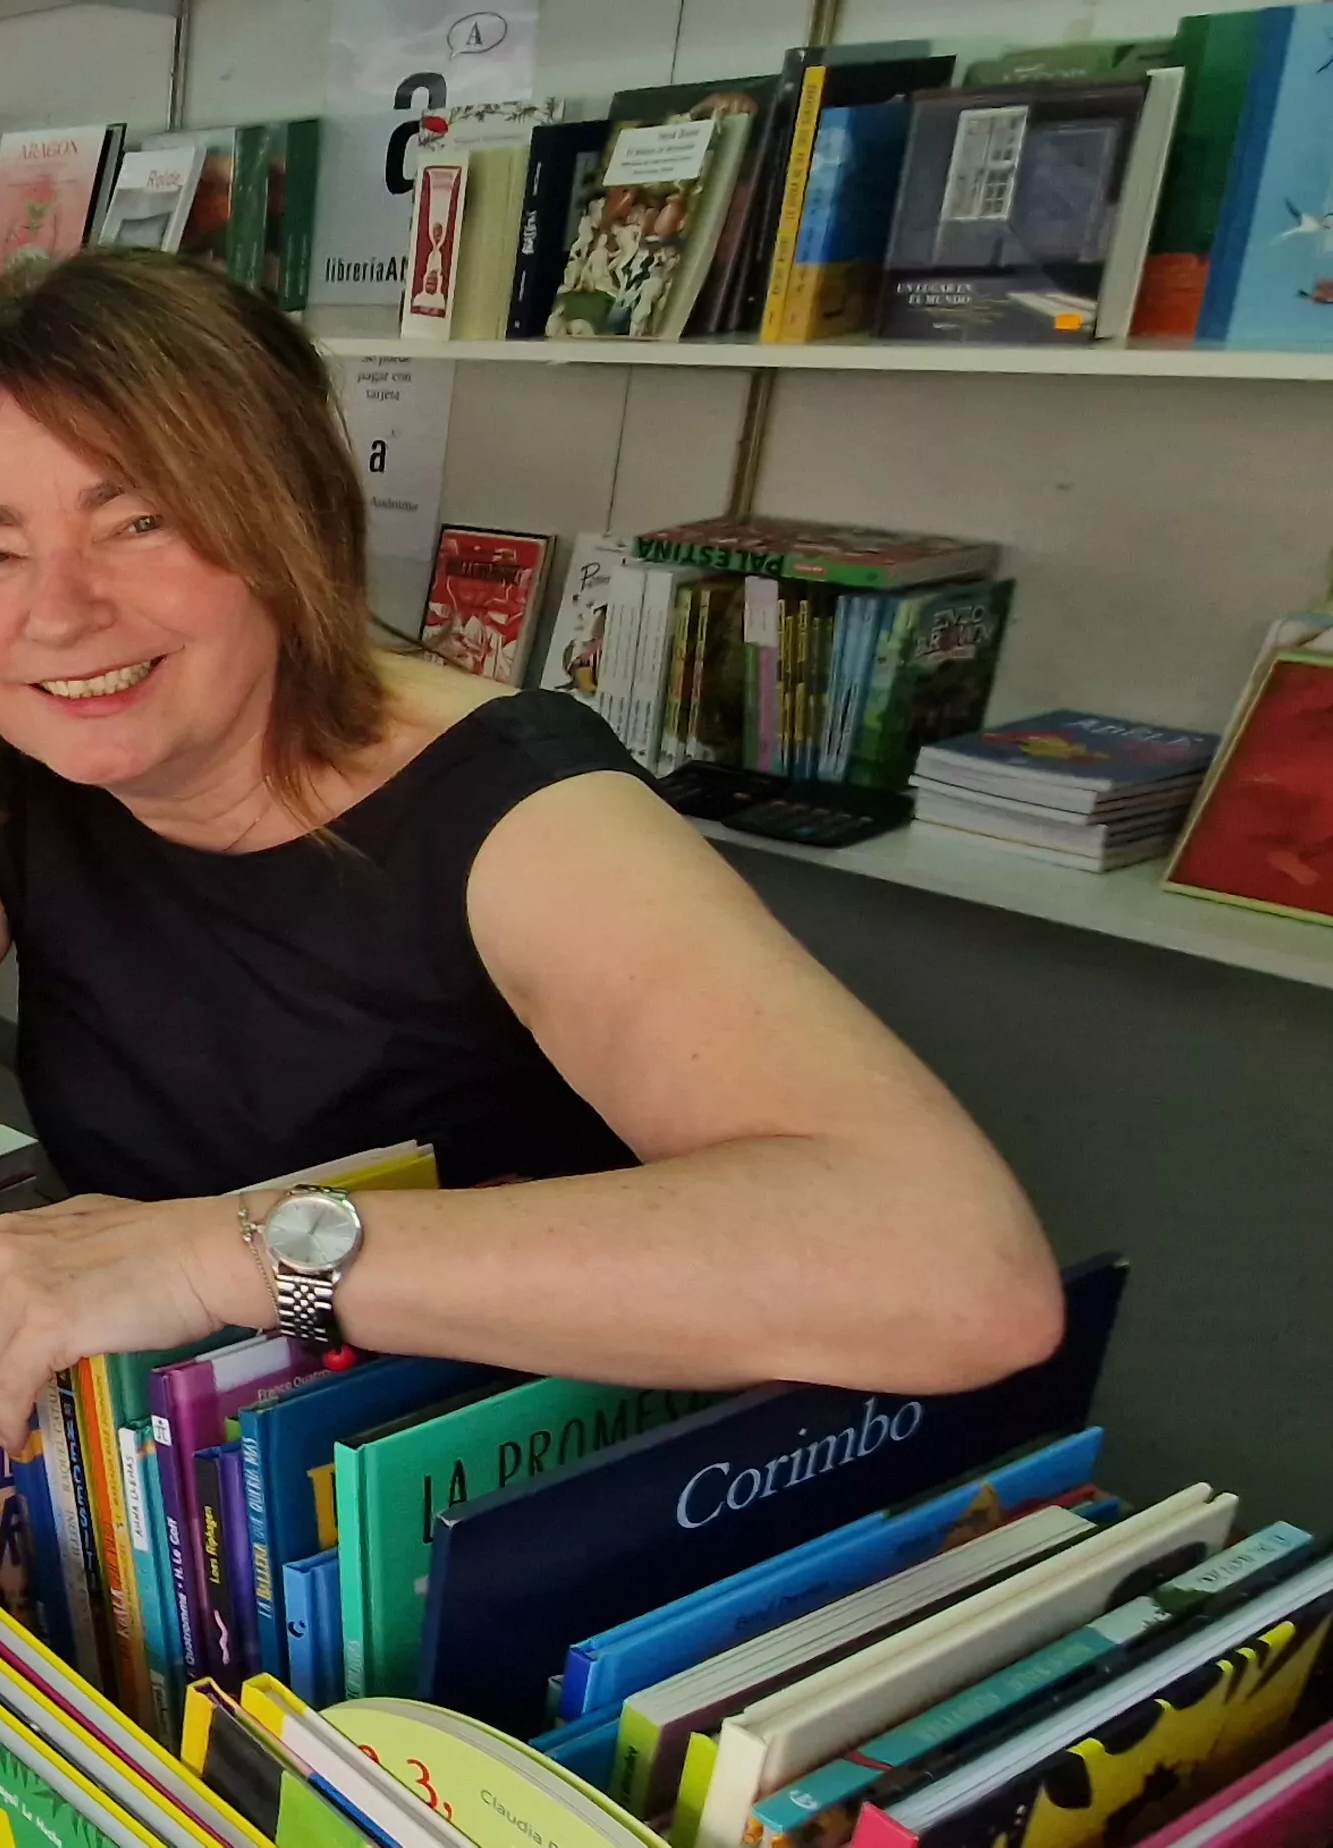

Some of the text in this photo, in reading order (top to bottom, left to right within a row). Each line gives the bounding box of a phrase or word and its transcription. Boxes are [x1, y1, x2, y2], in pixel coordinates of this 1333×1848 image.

[466, 21, 483, 46] A
[368, 438, 388, 474] a
[636, 537, 785, 575] PALESTINA
[56, 1443, 71, 1493] RAQUEL
[676, 1397, 923, 1530] Corimbo
[124, 1454, 144, 1538] ANNA LLENAS
[422, 1458, 469, 1548] LA
[252, 1542, 273, 1601] BALLENA
[257, 1600, 273, 1620] LA
[478, 1788, 543, 1846] Claudia
